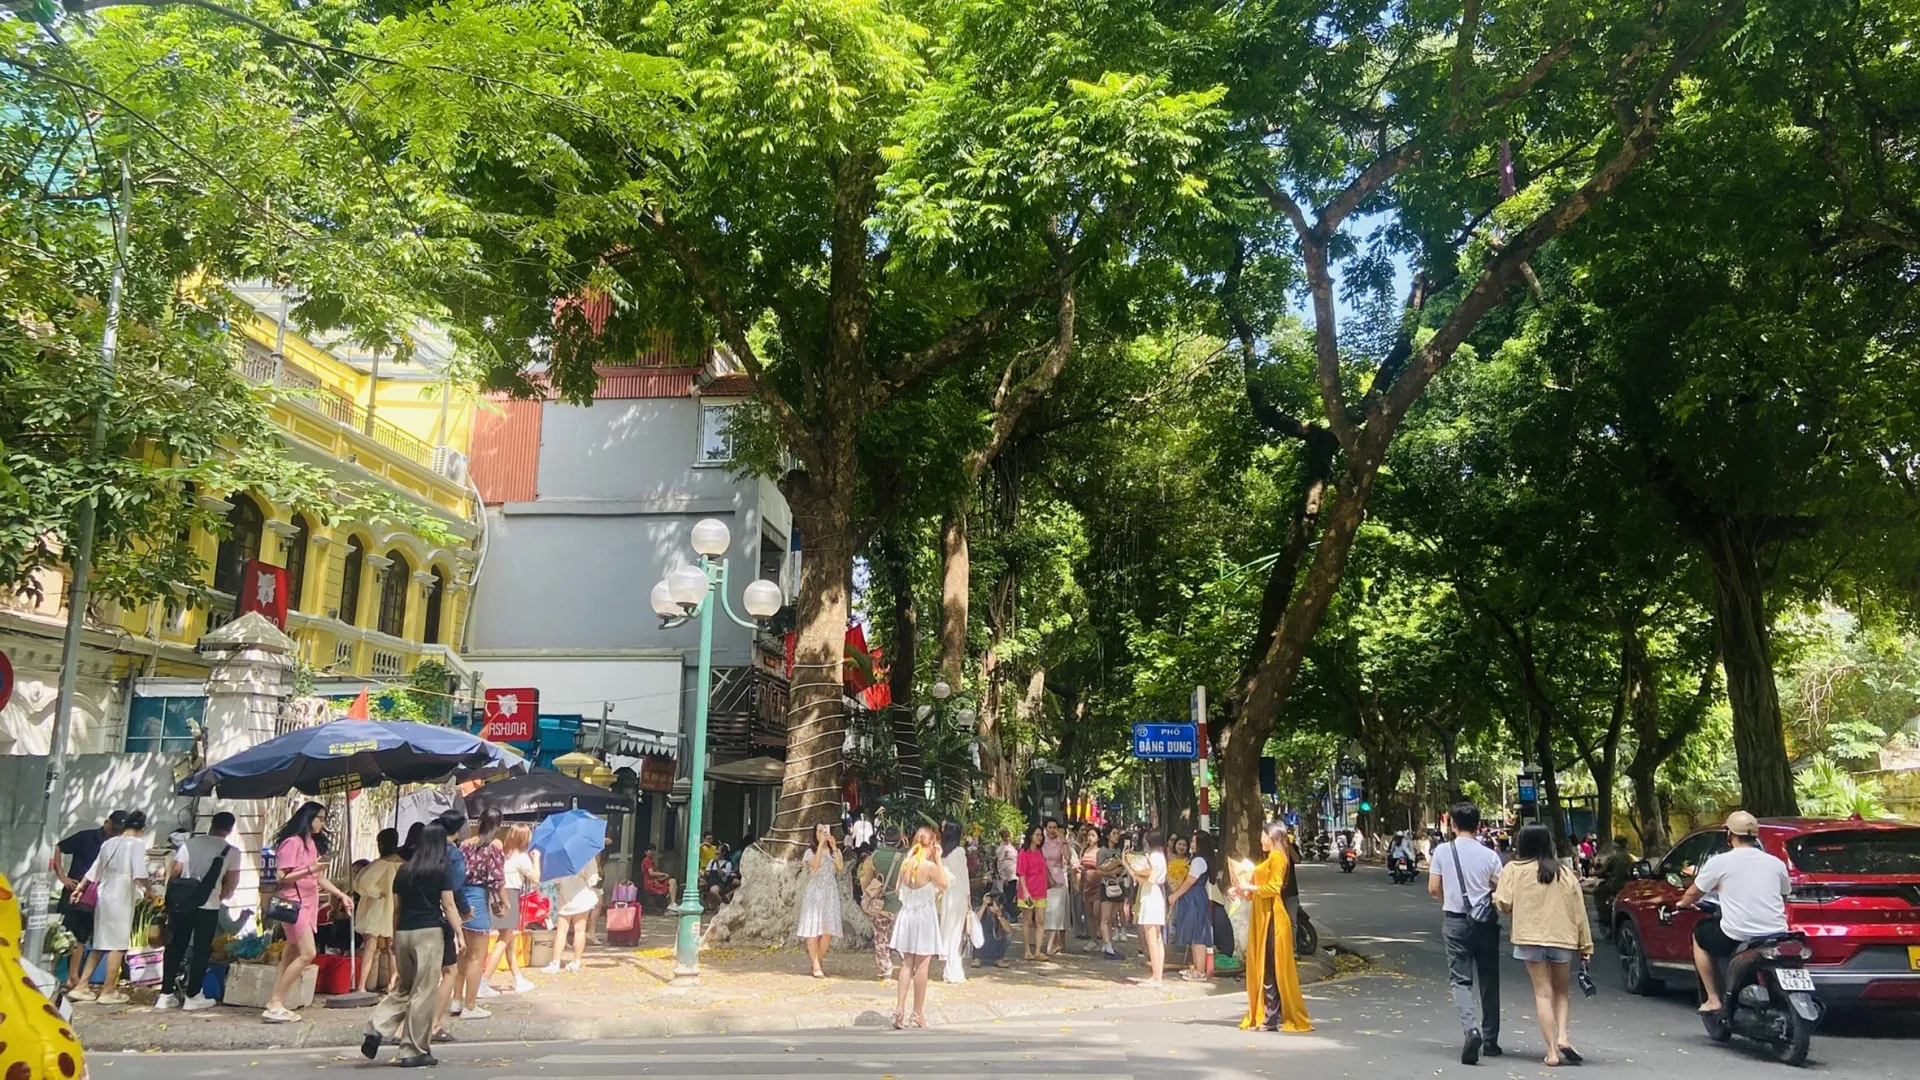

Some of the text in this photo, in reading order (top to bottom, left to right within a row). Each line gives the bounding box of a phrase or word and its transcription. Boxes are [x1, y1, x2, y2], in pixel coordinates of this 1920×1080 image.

[488, 722, 527, 736] ASHIMA
[1161, 727, 1180, 735] PHỐ
[1138, 738, 1192, 755] ĐẶNG DUNG
